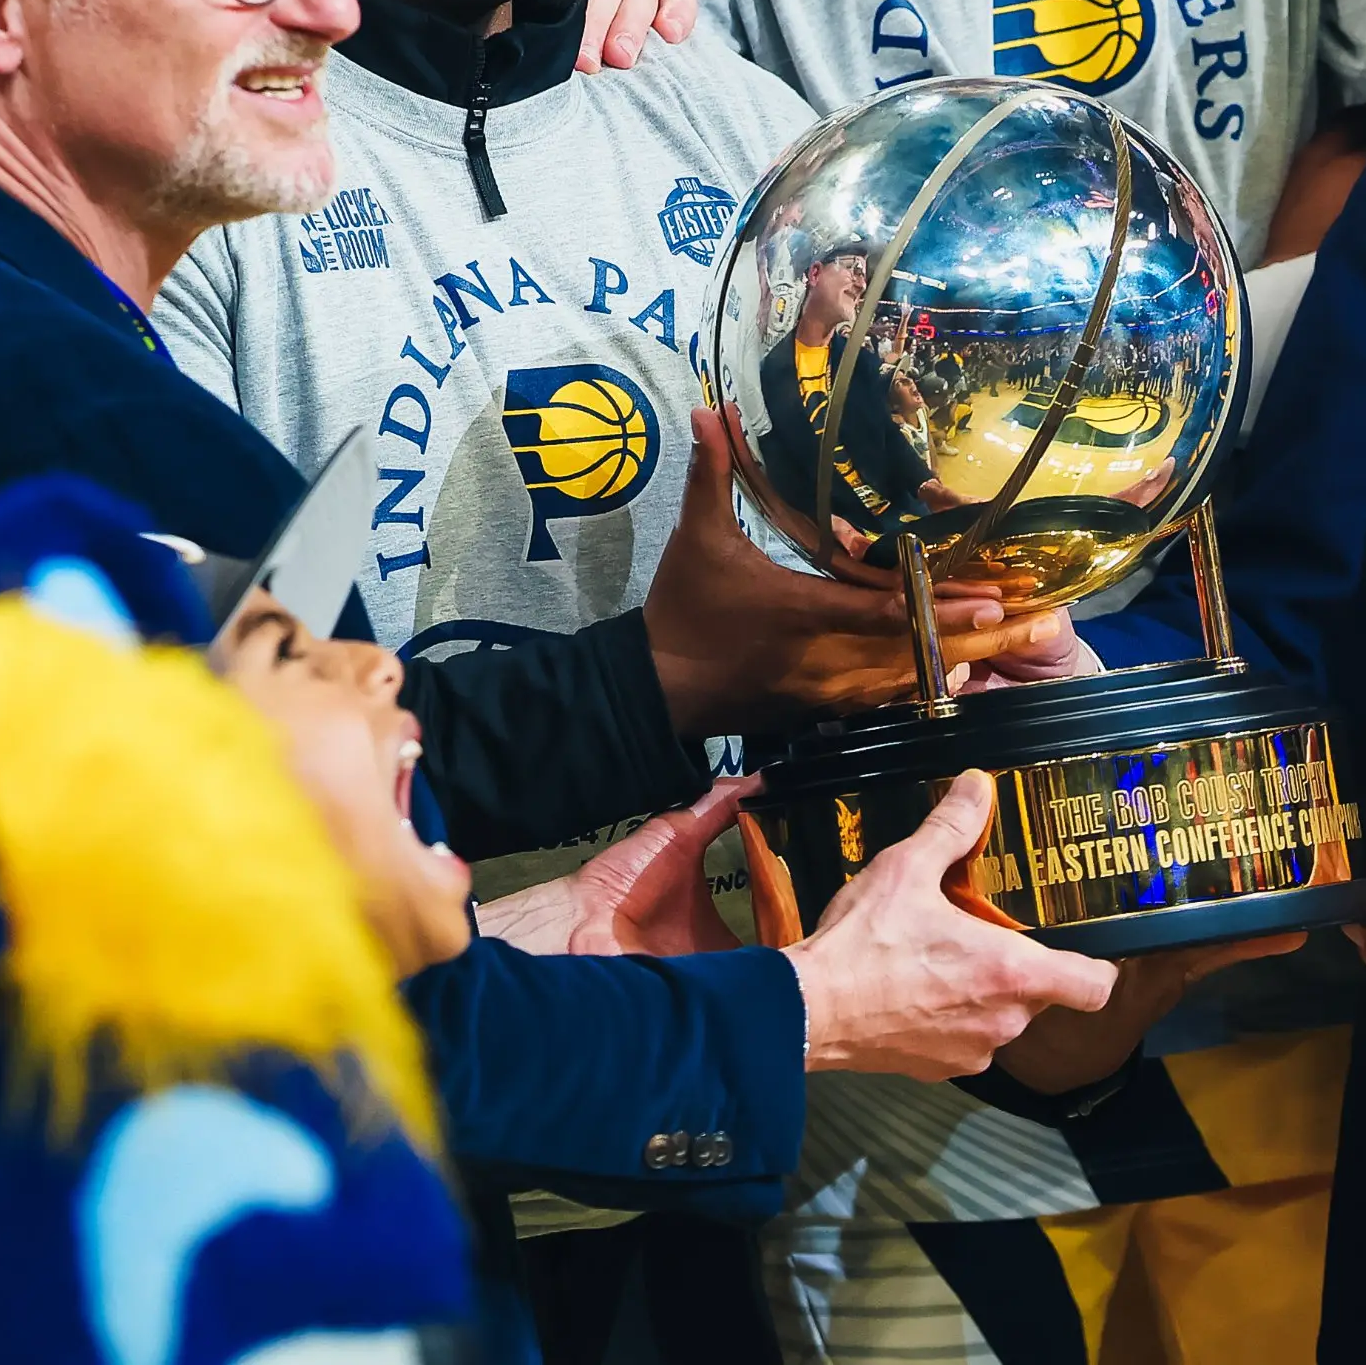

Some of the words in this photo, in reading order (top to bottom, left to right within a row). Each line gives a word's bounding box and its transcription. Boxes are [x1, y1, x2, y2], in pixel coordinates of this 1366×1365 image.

[679, 179, 701, 192] NBA
[333, 228, 390, 271] ROOM
[1049, 793, 1107, 839] THE
[1112, 783, 1170, 830] BOB
[1177, 770, 1256, 820] COUSY
[1260, 760, 1329, 806] TROPHY
[1029, 833, 1150, 887] EASTERN
[1155, 811, 1297, 869] CONFERENCE
